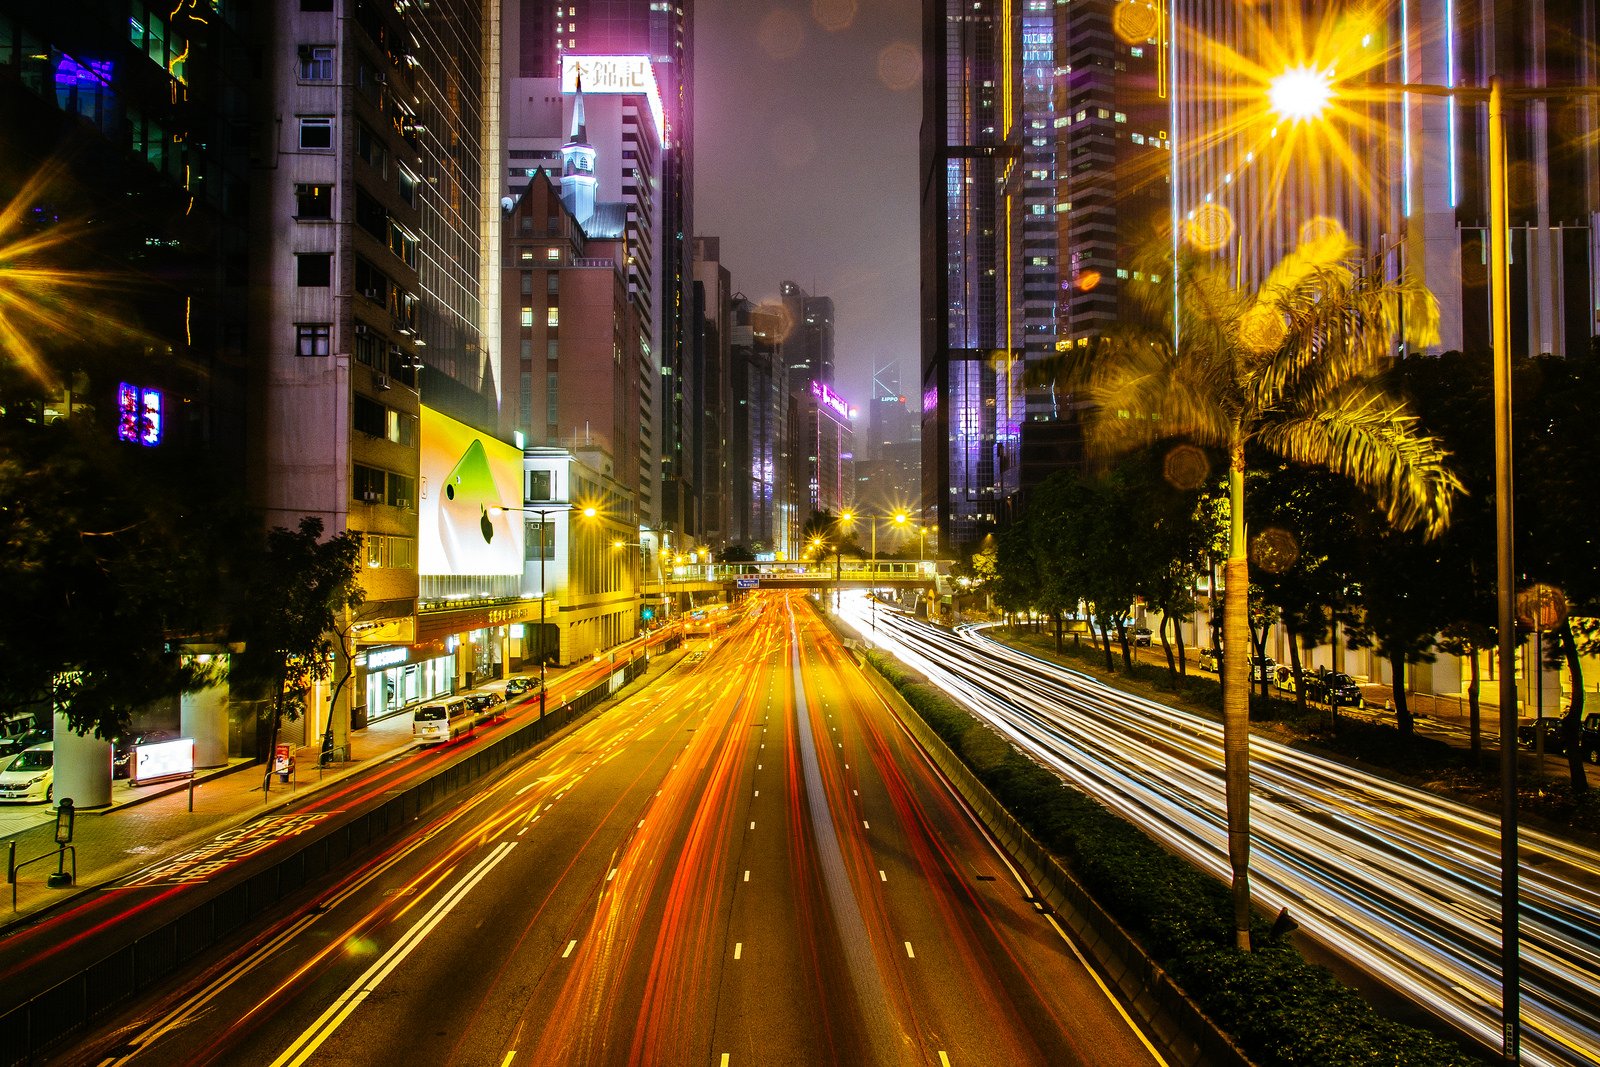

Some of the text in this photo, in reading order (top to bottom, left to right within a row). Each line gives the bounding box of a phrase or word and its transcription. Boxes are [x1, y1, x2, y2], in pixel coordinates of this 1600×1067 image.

[566, 61, 645, 88] 李錦記
[215, 824, 316, 841] CLEAR
[246, 814, 329, 829] KEEP
[172, 838, 280, 862] 請勿
[121, 858, 241, 888] 停車
